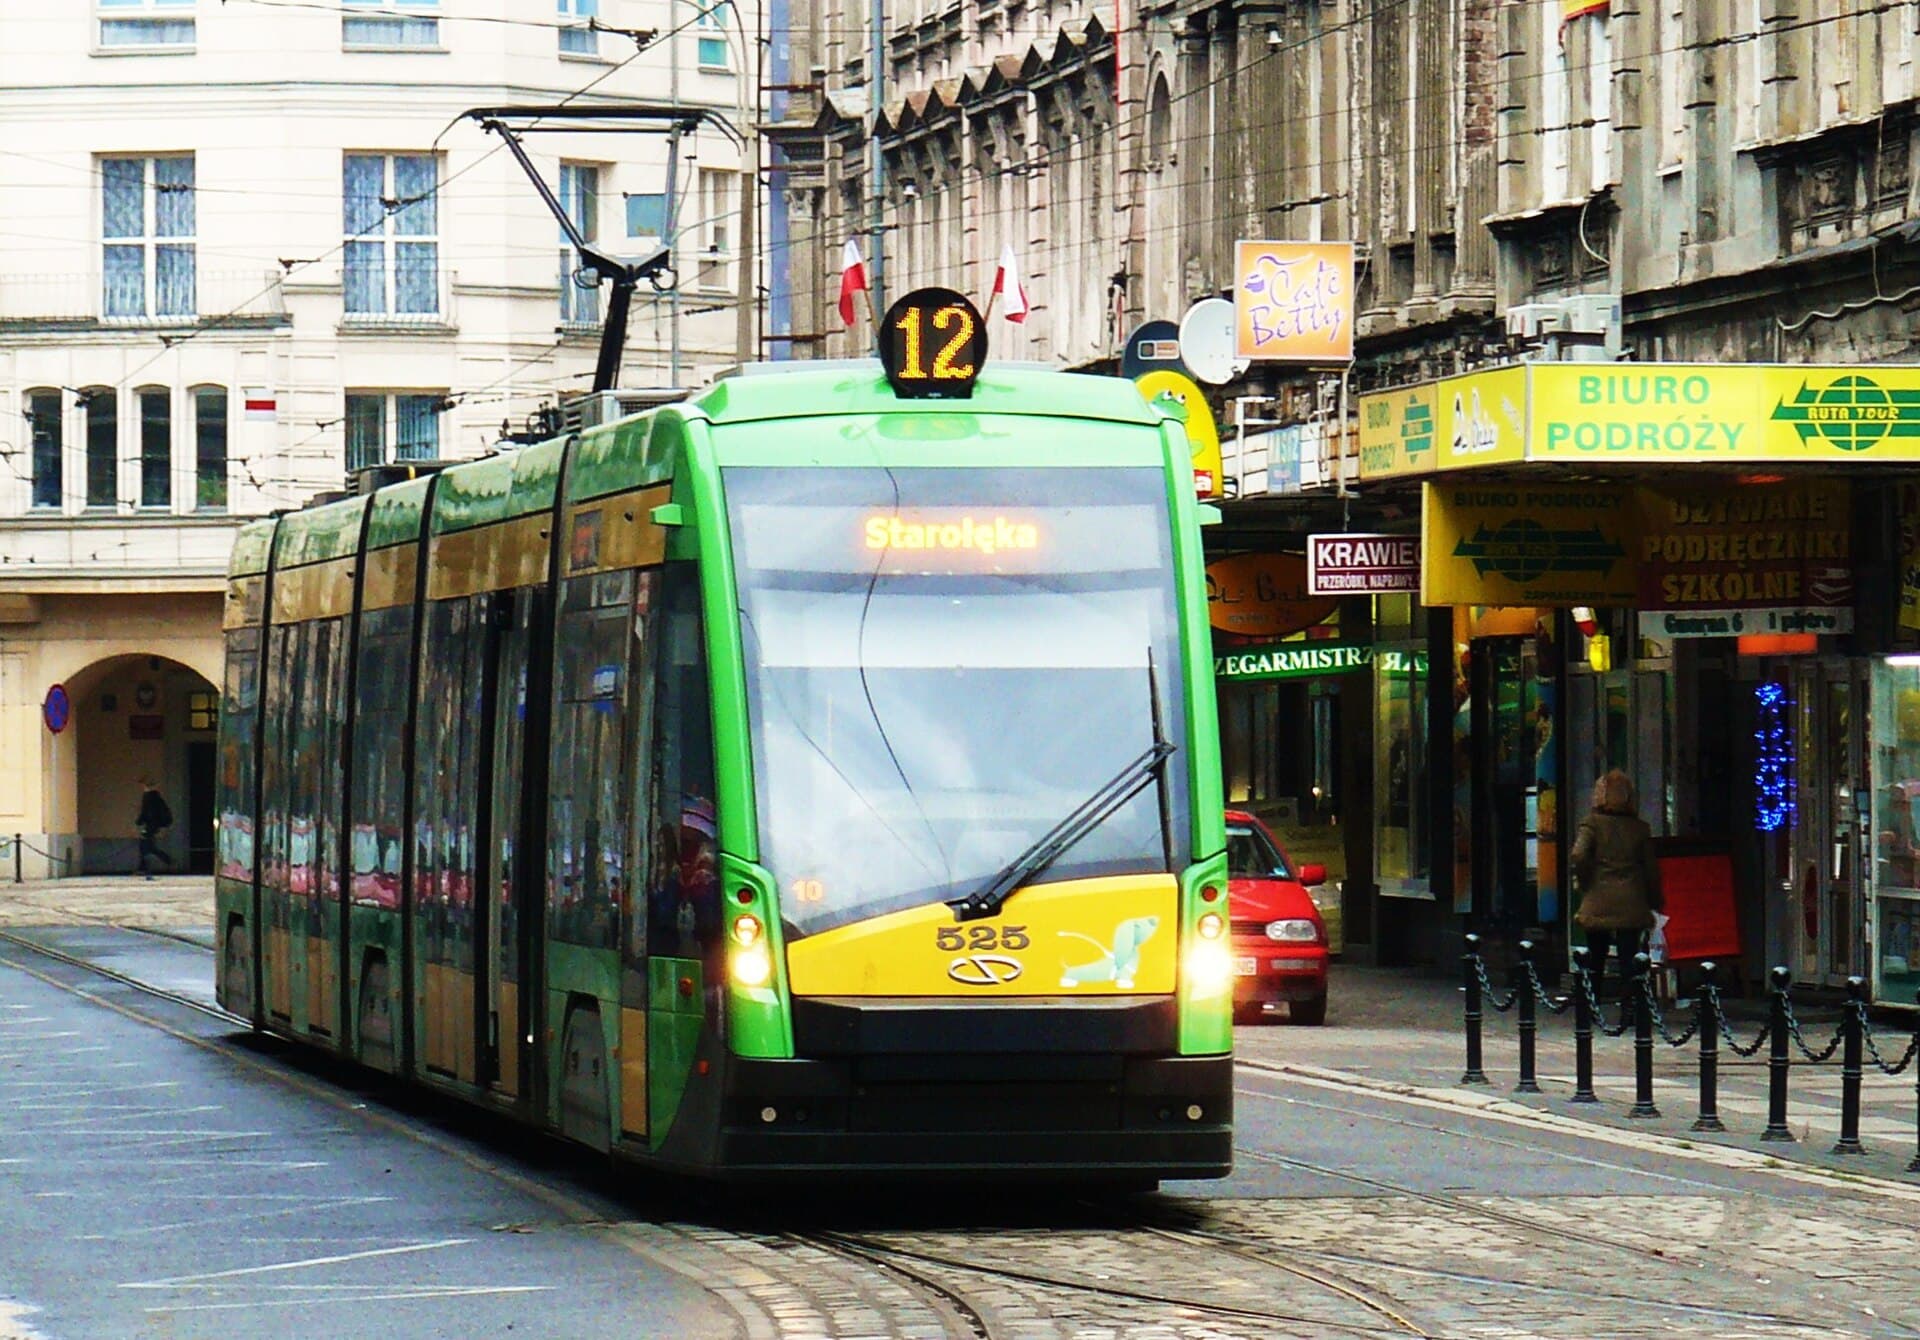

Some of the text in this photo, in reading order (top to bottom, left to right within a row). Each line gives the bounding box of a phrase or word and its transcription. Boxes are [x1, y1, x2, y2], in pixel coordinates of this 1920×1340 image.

[1248, 304, 1342, 346] Betty
[896, 306, 974, 380] 12
[1579, 375, 1710, 404] BIURO
[1857, 406, 1900, 420] TOUR
[1548, 414, 1745, 451] PODRÓŻY
[1454, 492, 1519, 507] BIURO
[865, 516, 1038, 554] Starołęka
[1643, 531, 1850, 569] PODRĘCZNIKI
[1662, 569, 1802, 603] SZKOLNE
[1733, 612, 1744, 632] 6
[792, 879, 823, 901] 10
[936, 925, 1031, 952] 525
